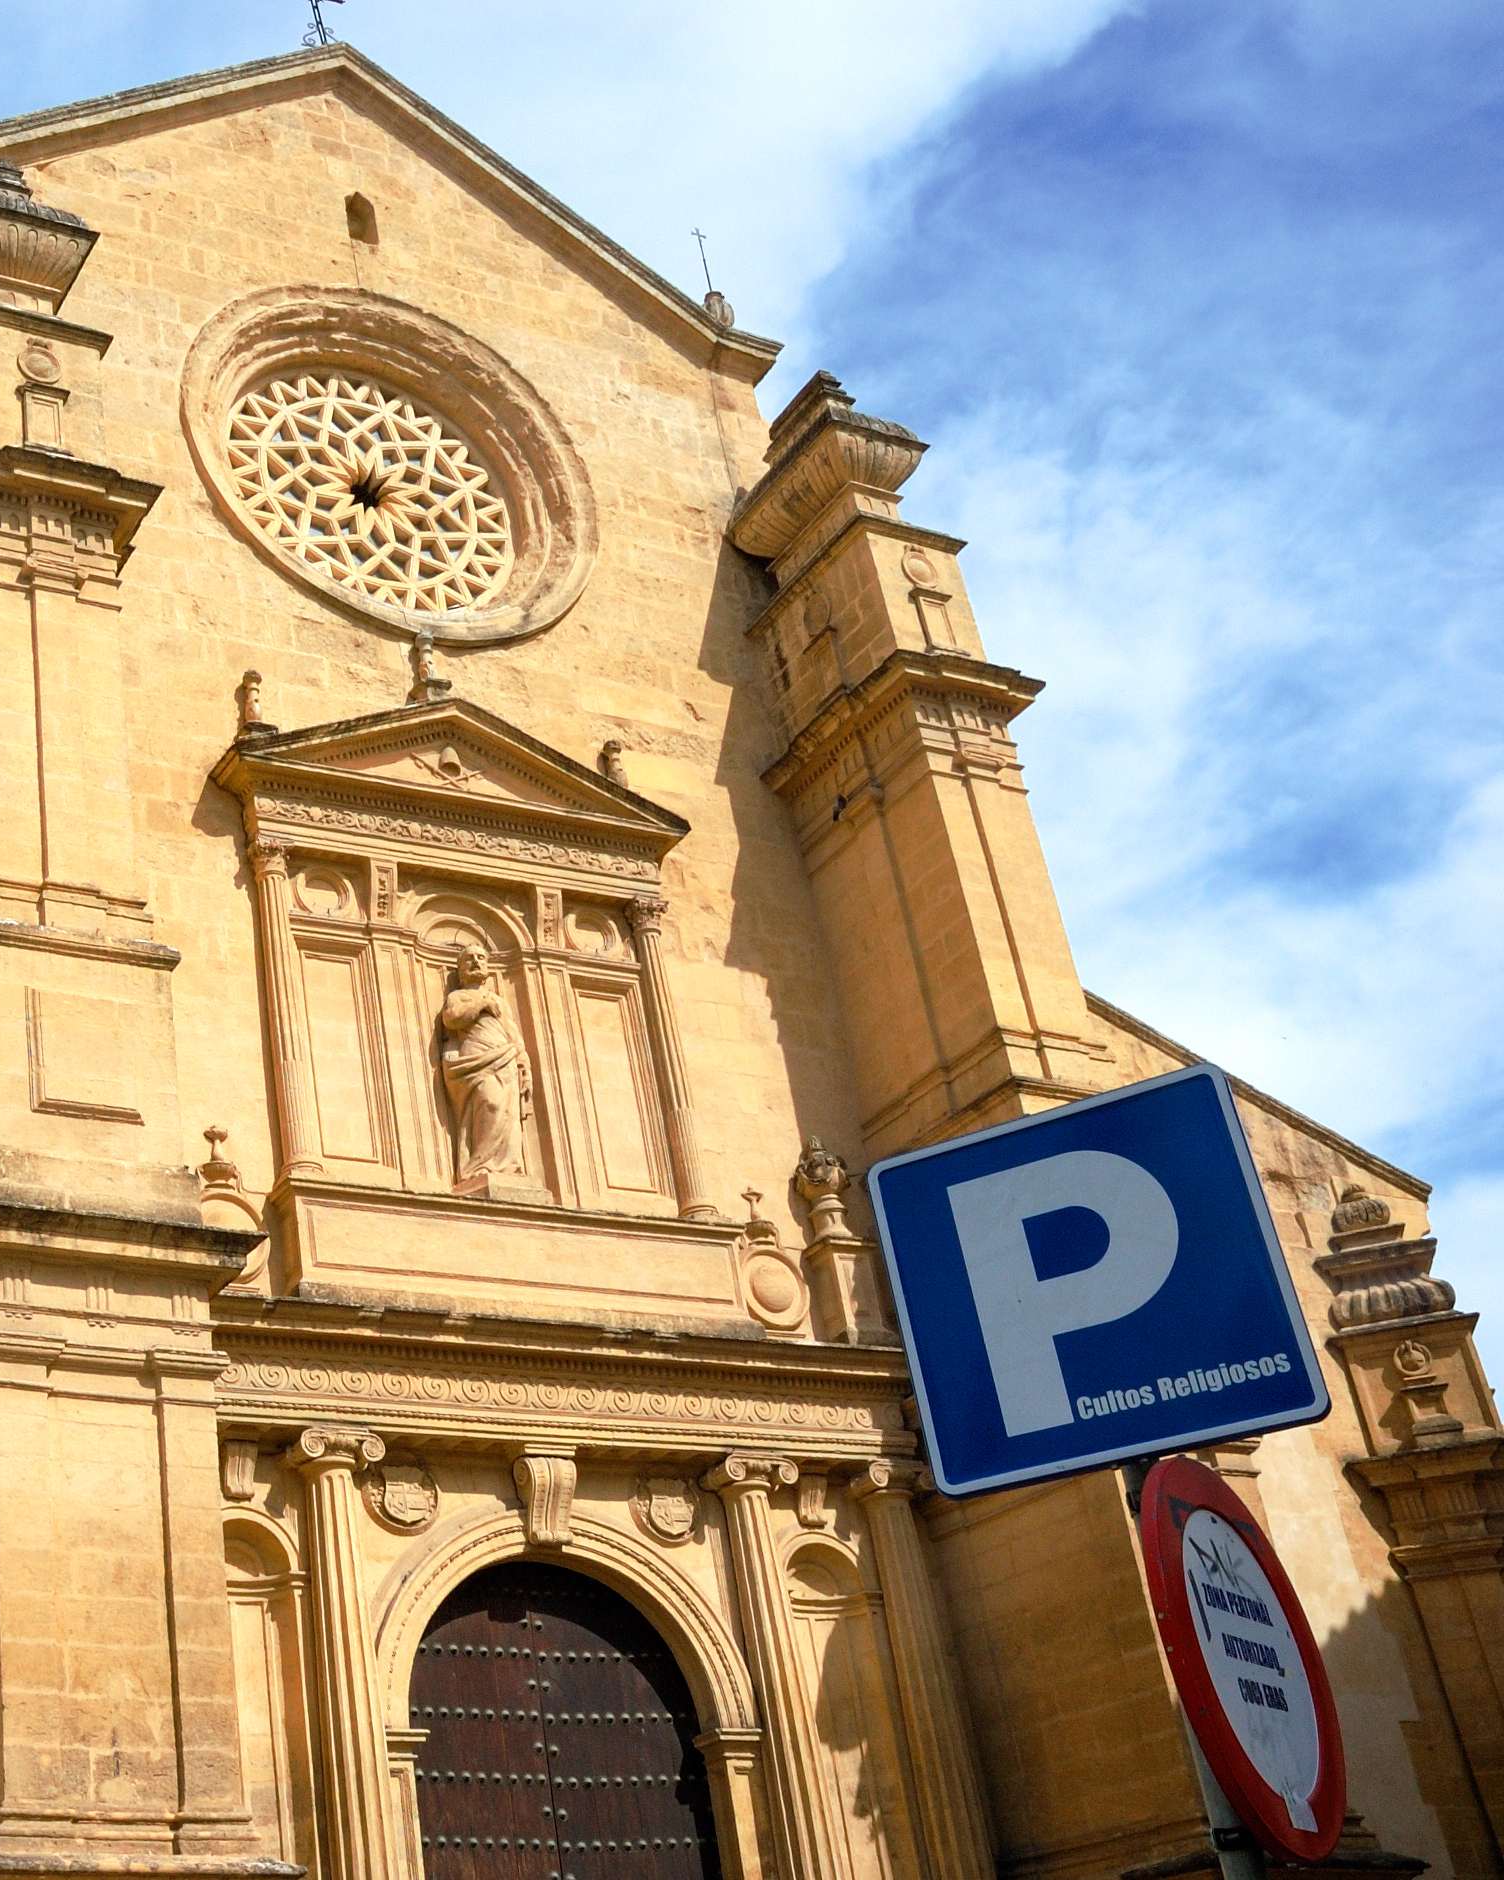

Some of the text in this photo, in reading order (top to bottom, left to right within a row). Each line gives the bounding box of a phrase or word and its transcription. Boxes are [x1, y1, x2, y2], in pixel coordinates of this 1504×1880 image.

[946, 1150, 1179, 1438] P
[1076, 1353, 1291, 1420] Cultos Religiosos
[1201, 1582, 1230, 1612] ZONA
